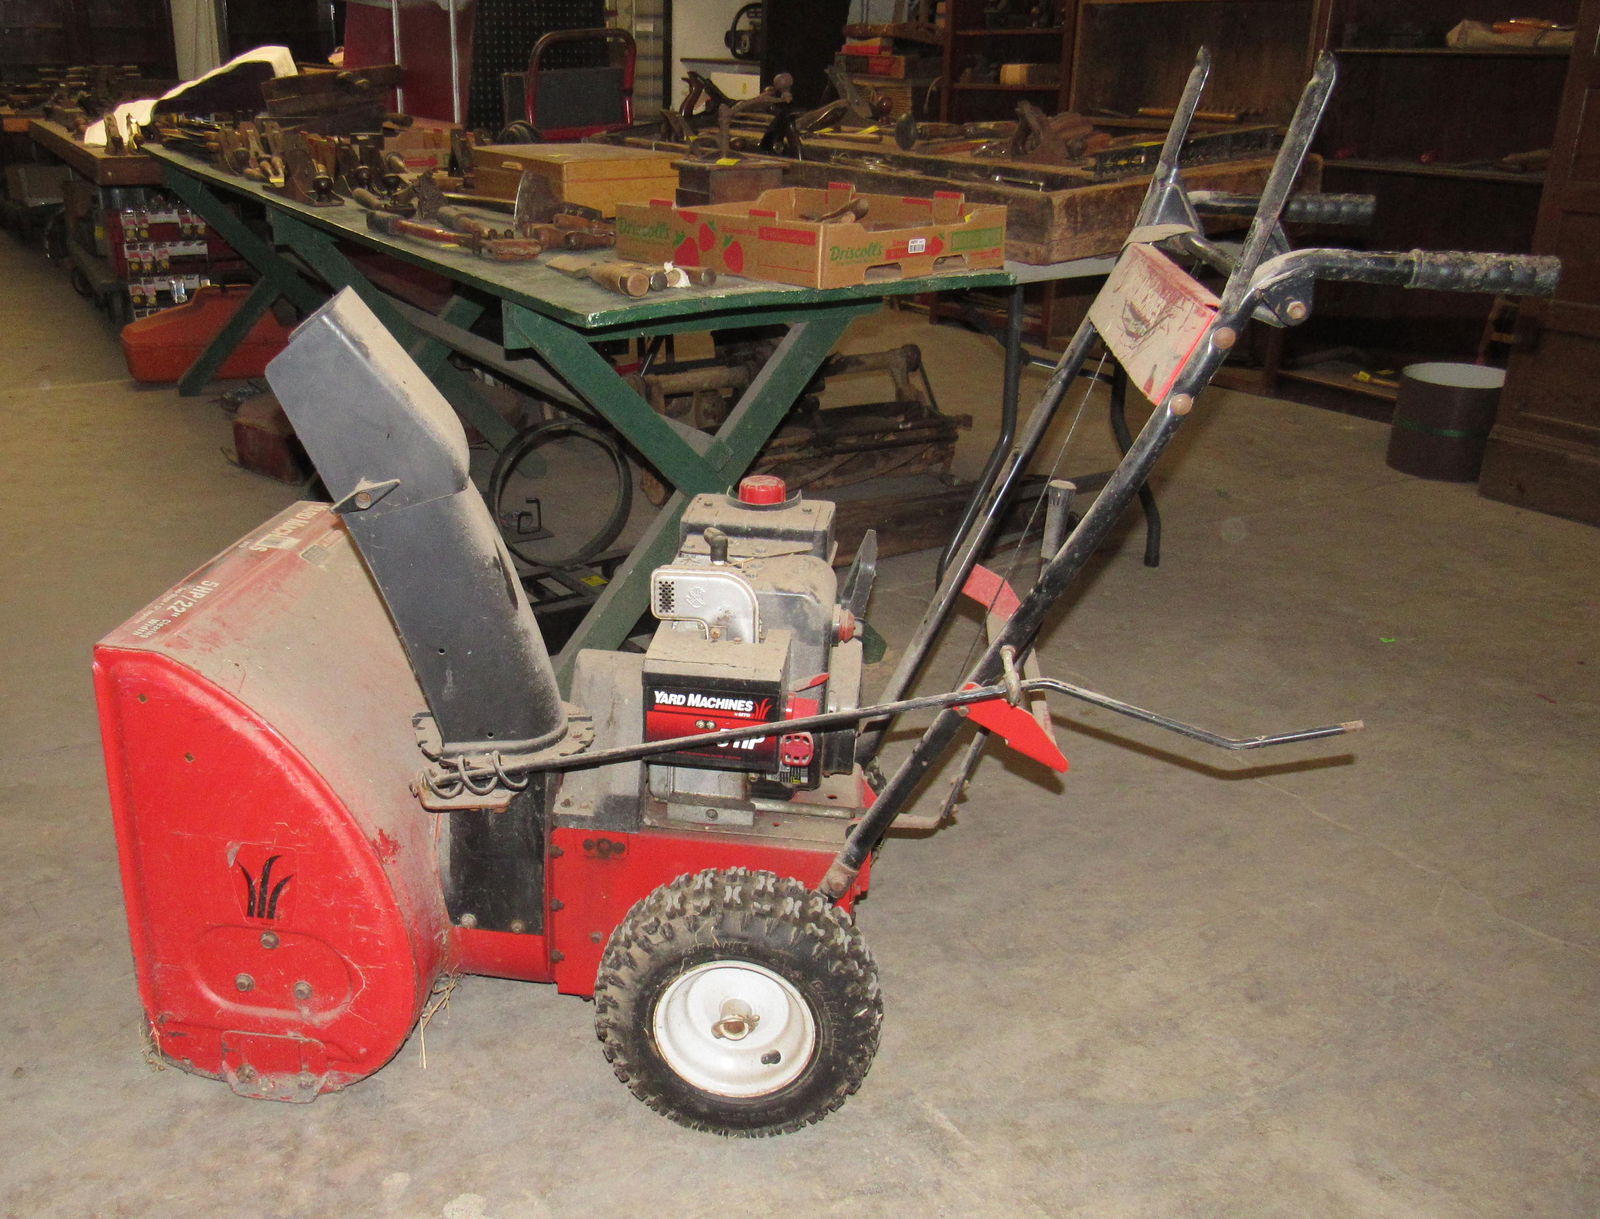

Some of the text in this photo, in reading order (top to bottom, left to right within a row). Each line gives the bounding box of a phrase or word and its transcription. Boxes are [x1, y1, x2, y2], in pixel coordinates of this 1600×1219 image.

[830, 242, 882, 261] Driscoll's
[653, 690, 754, 712] YARD MACHINES
